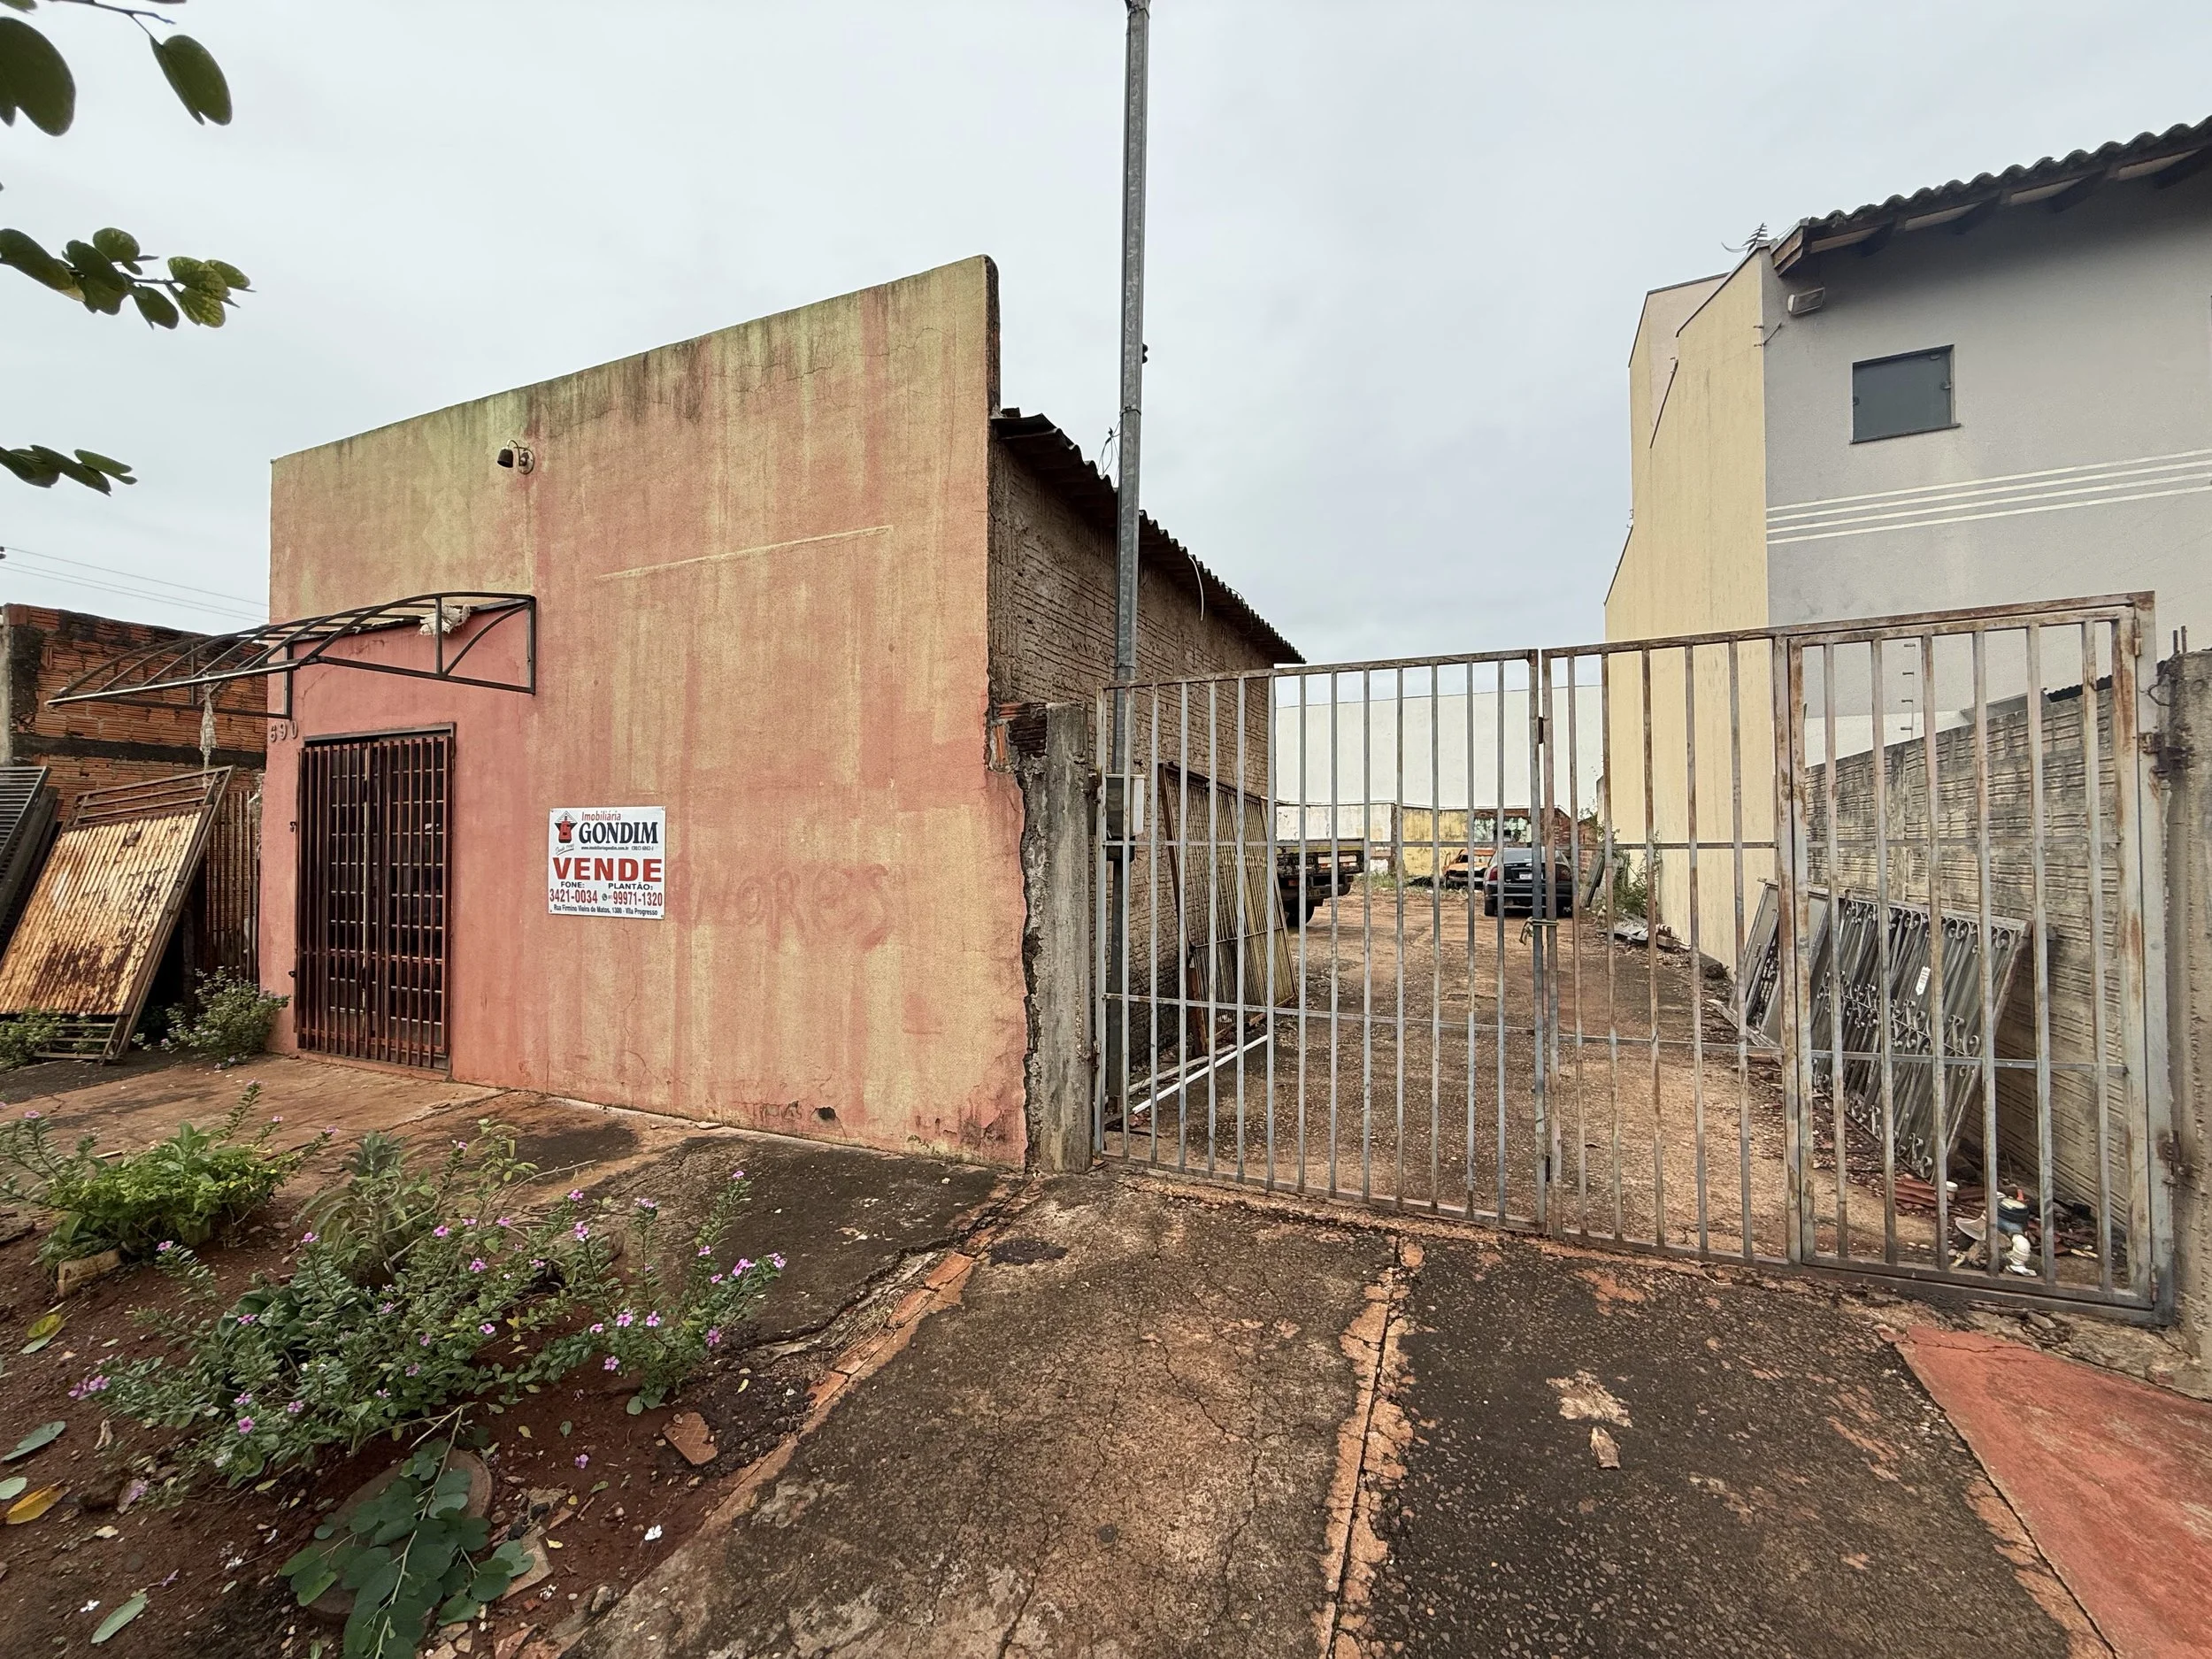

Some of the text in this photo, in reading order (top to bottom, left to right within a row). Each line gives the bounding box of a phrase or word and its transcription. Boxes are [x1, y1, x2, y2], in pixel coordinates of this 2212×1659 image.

[581, 810, 621, 821] Imobiliária
[579, 821, 658, 844] GONDIM
[552, 857, 662, 882] VENDE
[549, 888, 598, 903] 3421-0034
[613, 891, 663, 906] 99971-1320
